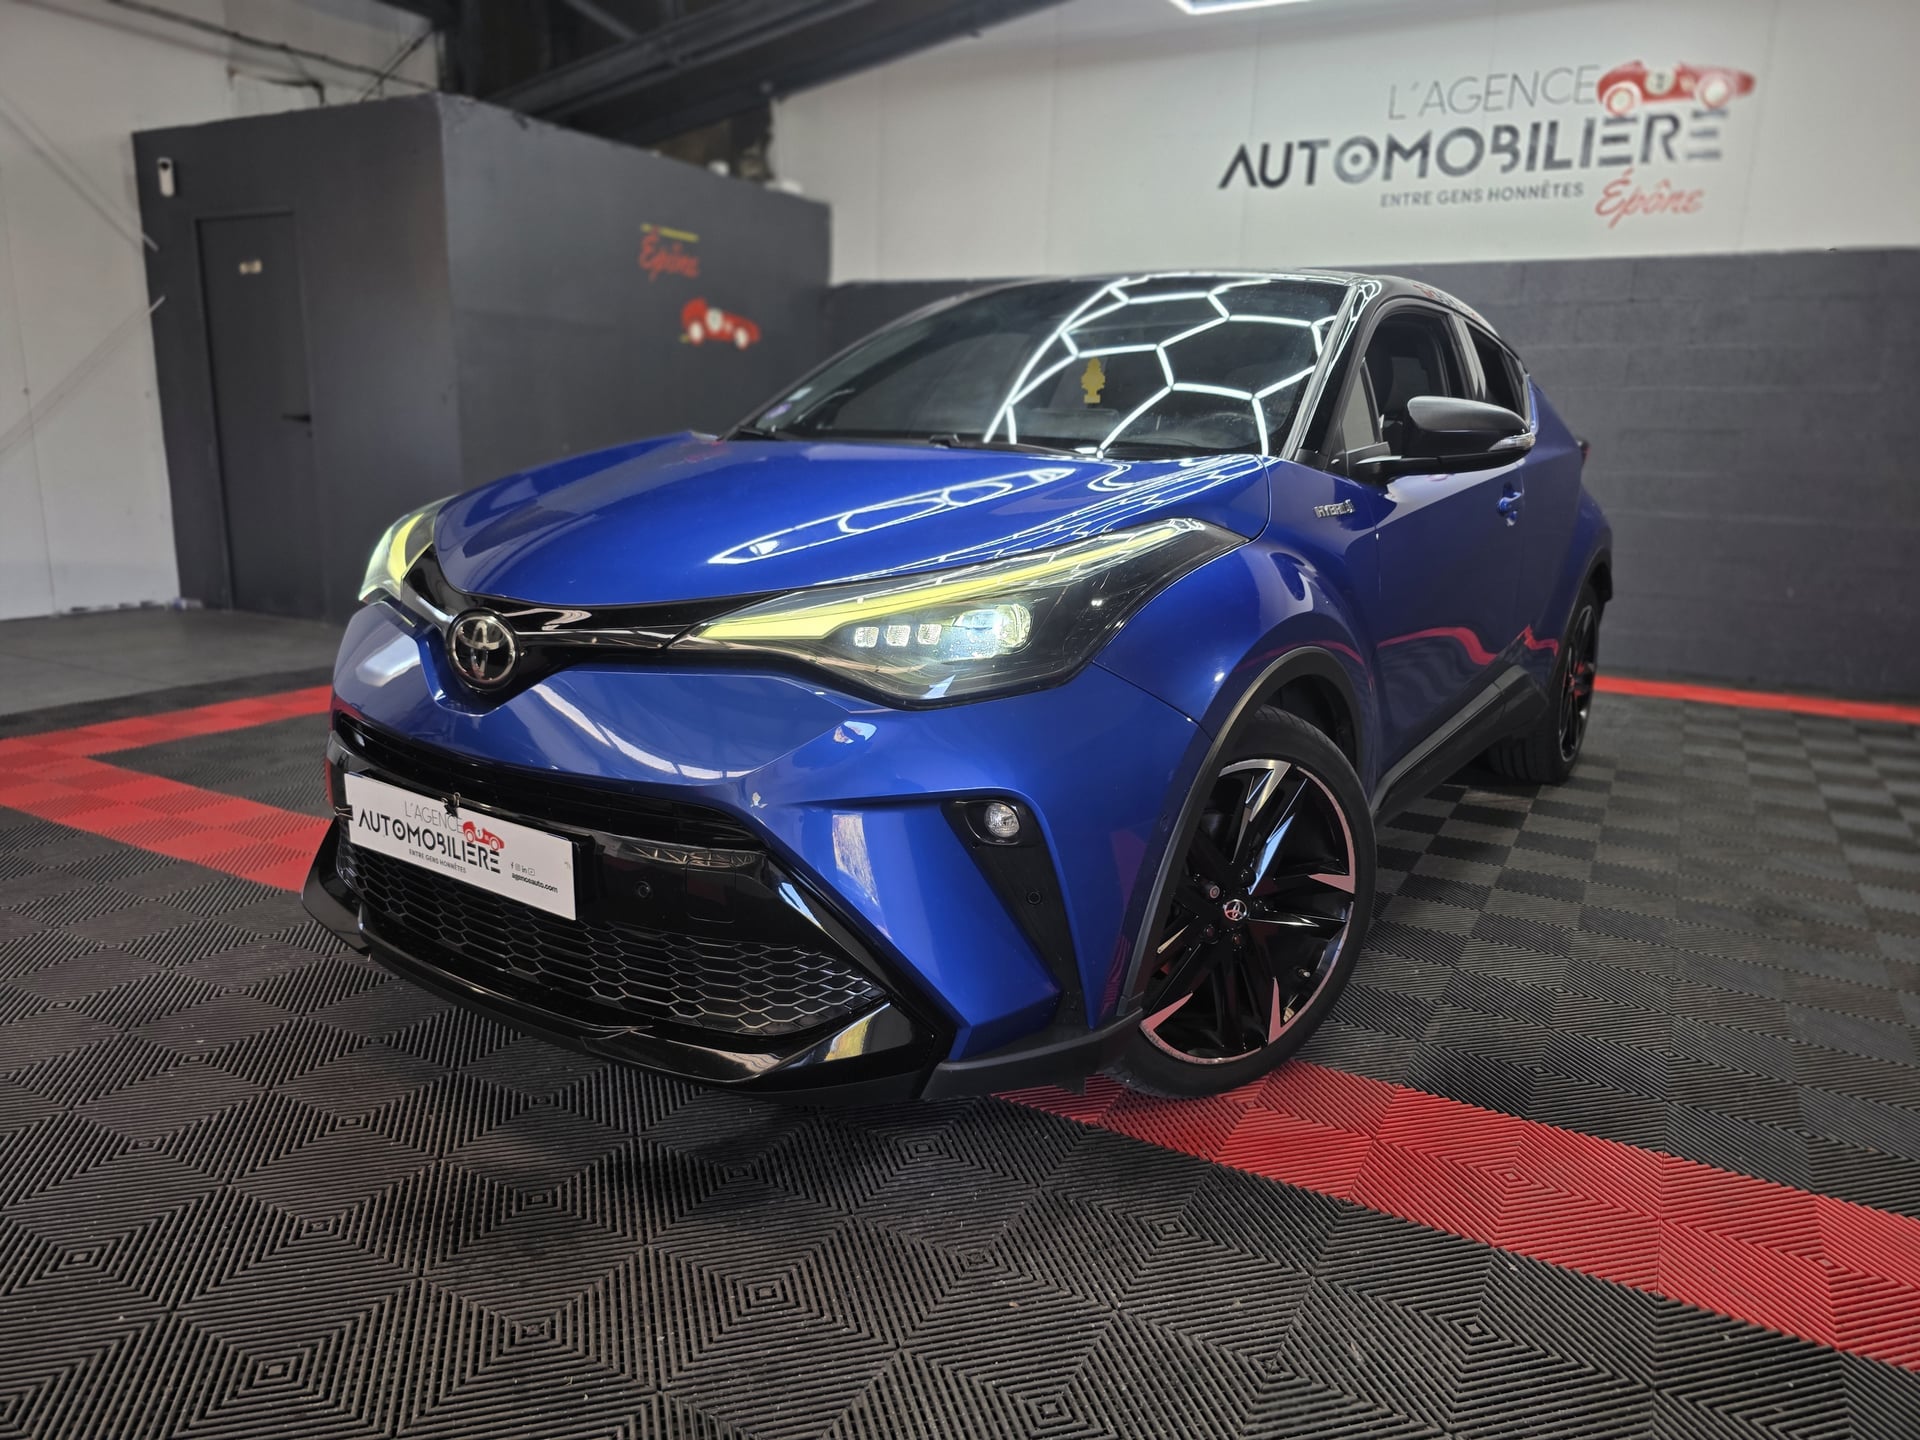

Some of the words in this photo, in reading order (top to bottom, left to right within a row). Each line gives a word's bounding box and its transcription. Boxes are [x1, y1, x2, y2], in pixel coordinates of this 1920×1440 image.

[1388, 64, 1600, 120] L'AGENCE
[1379, 191, 1433, 208] ENTRE
[1436, 188, 1484, 206] GENS
[1486, 179, 1585, 203] HONNÊTES
[1595, 168, 1705, 229] Épône
[404, 800, 464, 835] L'AGENCE
[408, 848, 424, 860] ENTRE
[425, 854, 439, 865] GENS
